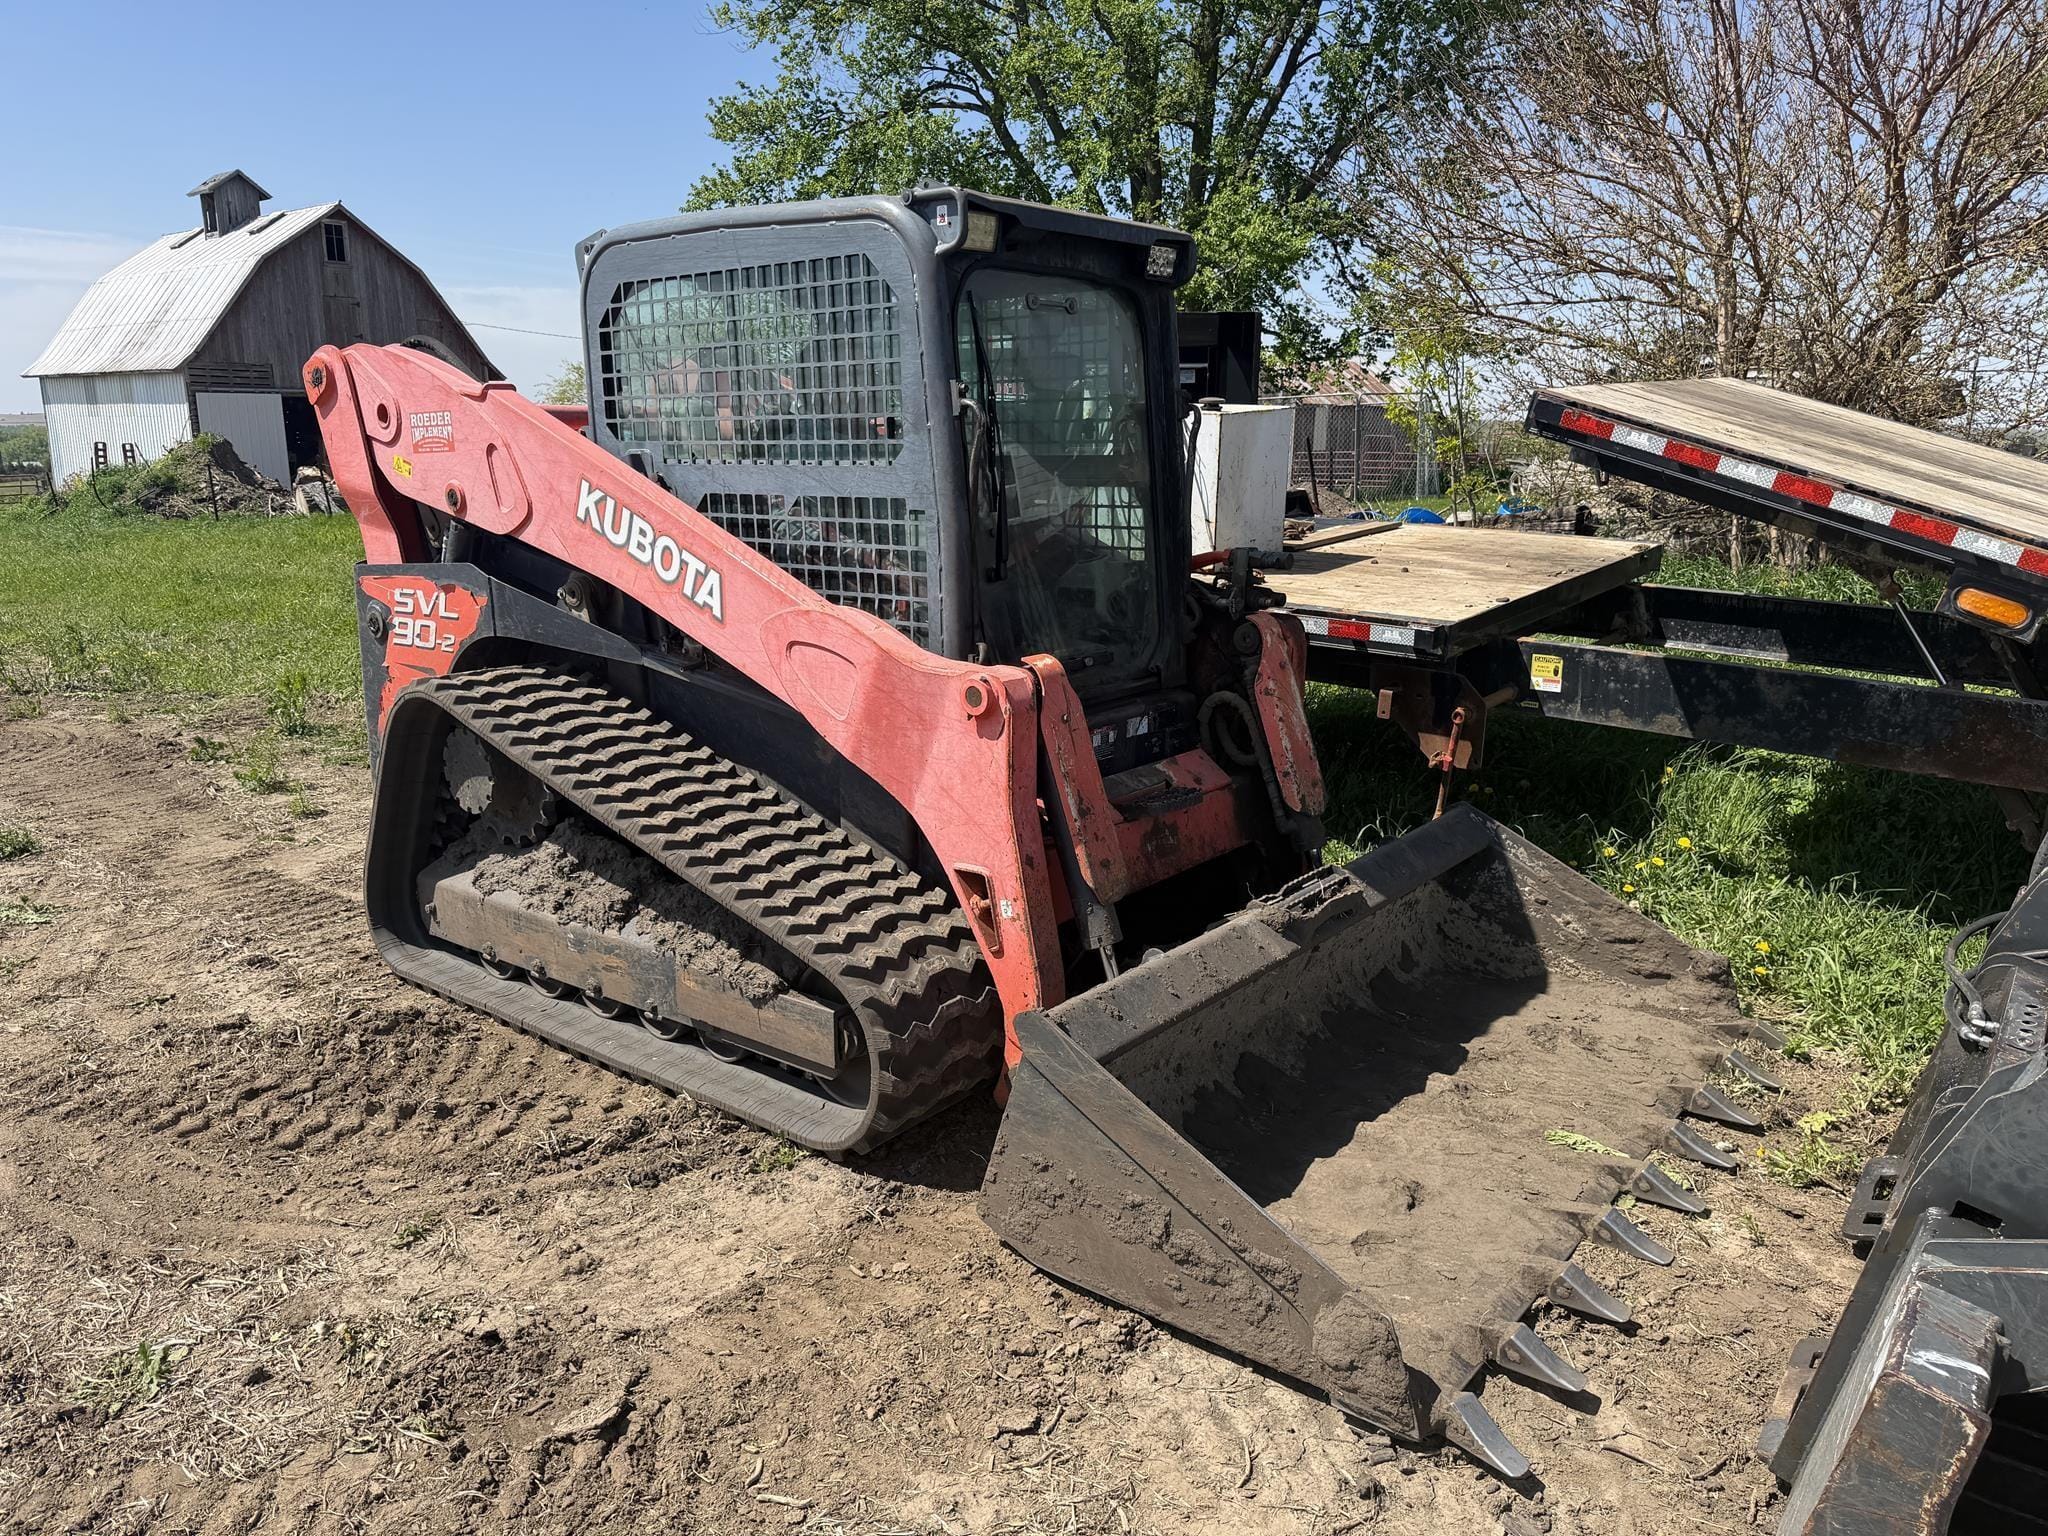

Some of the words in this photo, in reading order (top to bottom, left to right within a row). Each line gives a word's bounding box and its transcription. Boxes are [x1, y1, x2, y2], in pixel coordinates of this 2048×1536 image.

[410, 411, 452, 427] ROEDER
[411, 425, 453, 445] IMPLEMENT
[576, 478, 723, 622] KUBOTA
[394, 588, 459, 620] SVL
